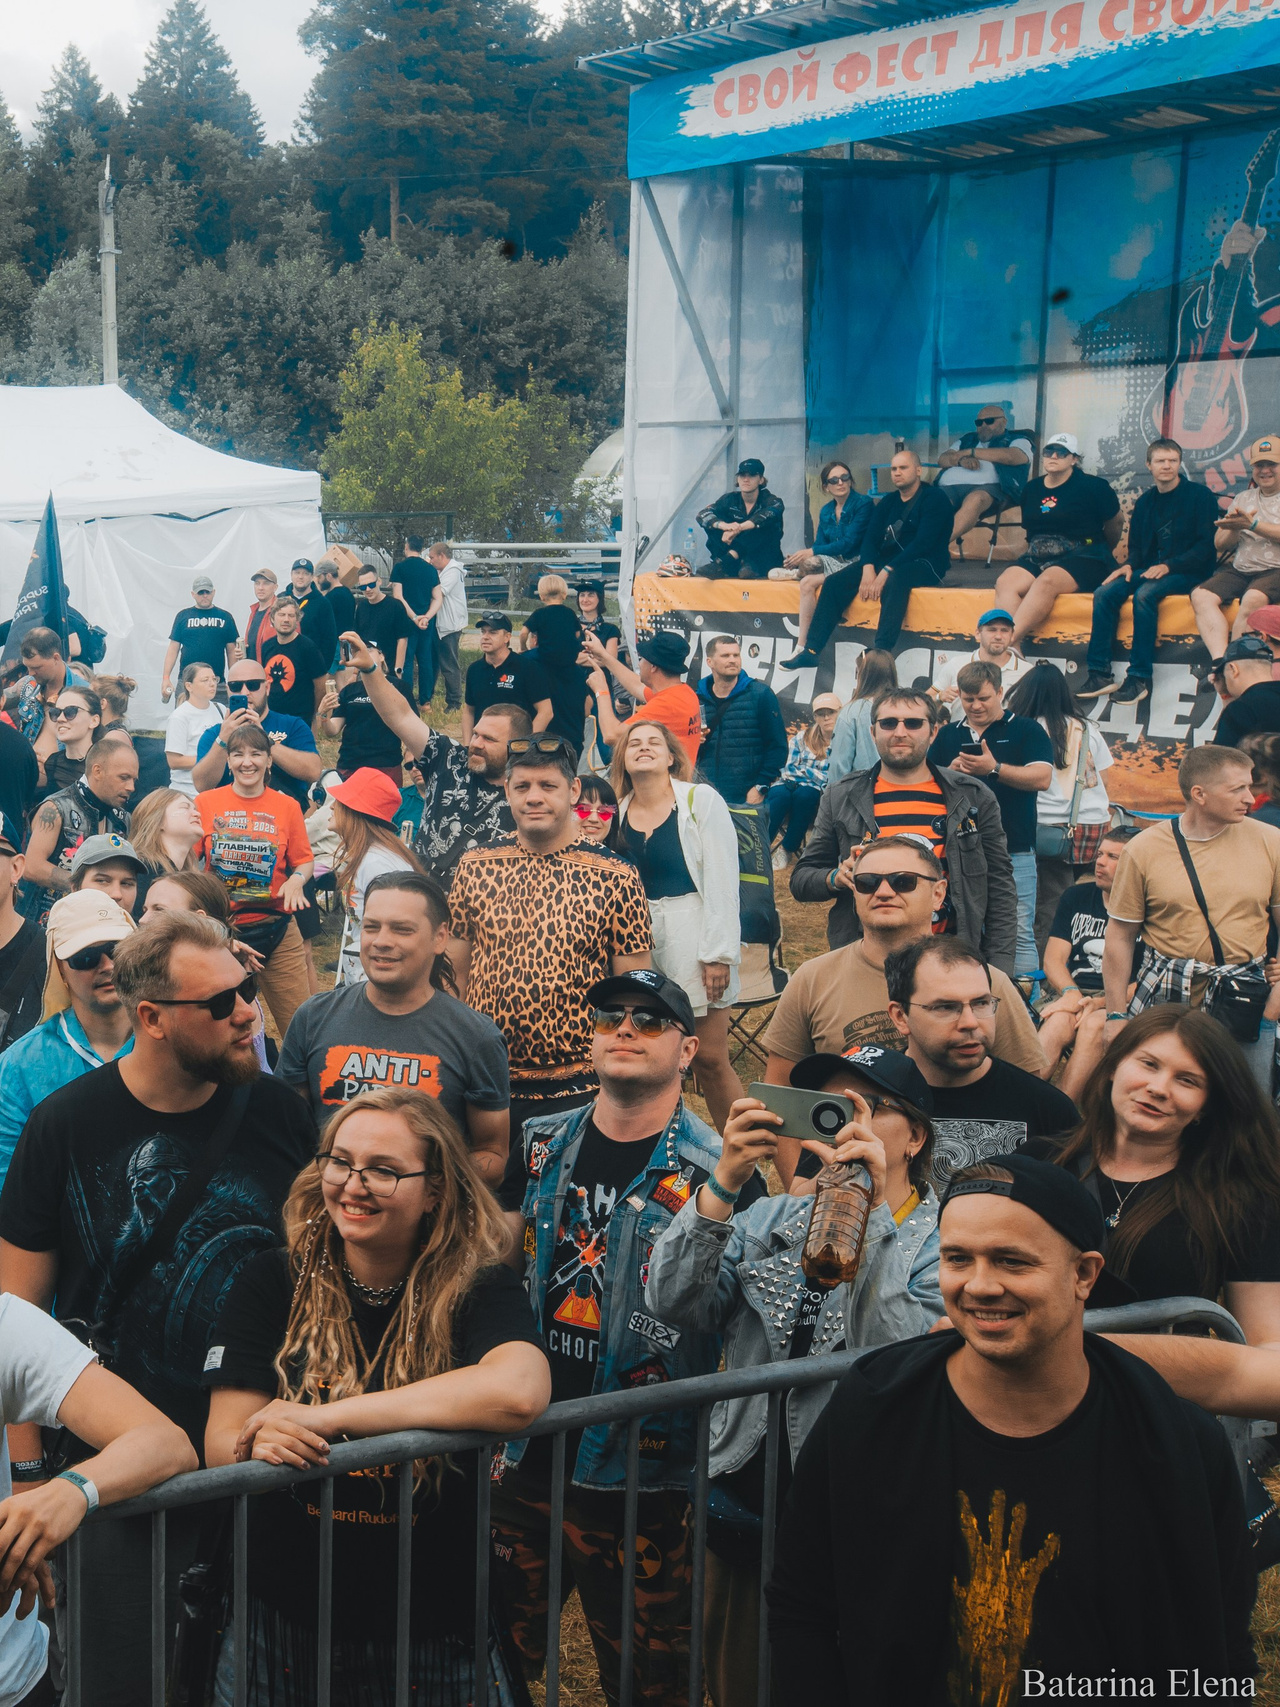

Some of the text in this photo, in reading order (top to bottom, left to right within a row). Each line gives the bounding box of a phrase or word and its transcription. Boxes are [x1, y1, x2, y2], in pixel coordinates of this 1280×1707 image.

[713, 0, 1280, 118] СВОЙ ФЕСТ ДЛЯ СВО
[187, 617, 225, 628] ПОФИГУ
[253, 821, 275, 834] 2025
[218, 842, 268, 853] ГЛАВНЫЙ
[340, 1052, 432, 1085] ANTI-
[307, 1503, 356, 1523] Beard
